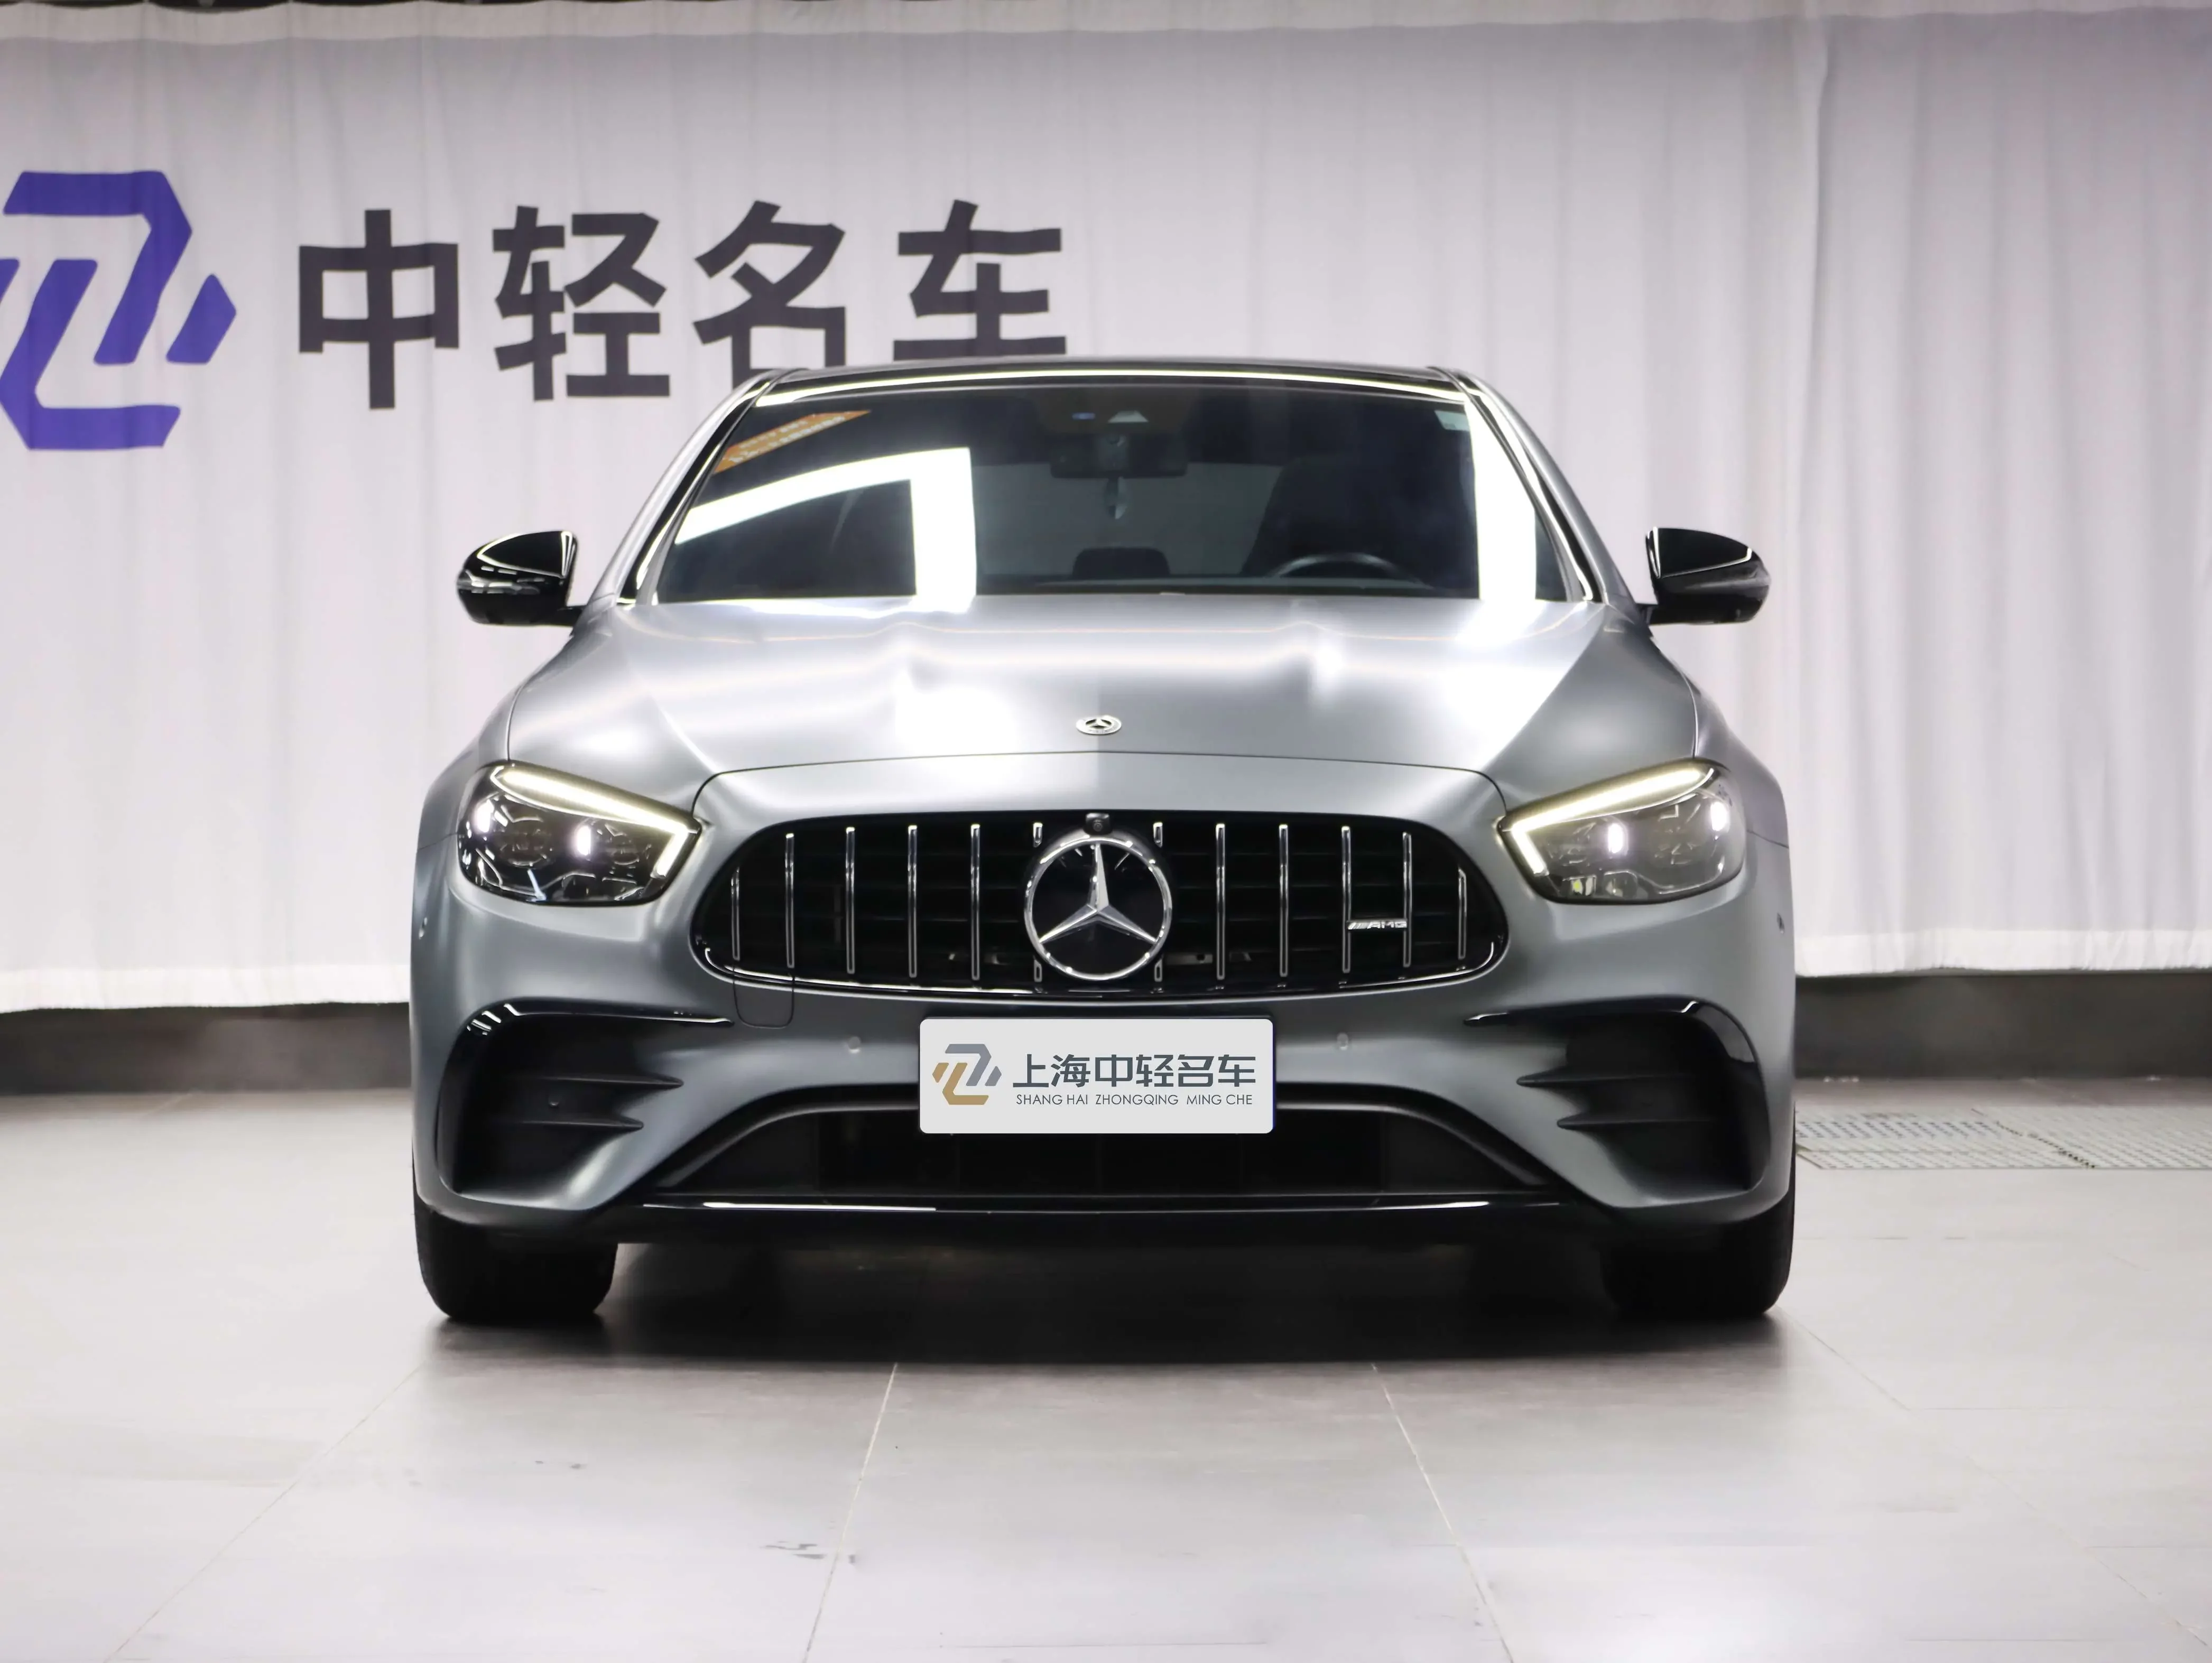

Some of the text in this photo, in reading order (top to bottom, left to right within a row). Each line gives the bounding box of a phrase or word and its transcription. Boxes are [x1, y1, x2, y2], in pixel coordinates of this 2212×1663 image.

[299, 200, 1066, 409] 中轻名车
[1366, 921, 1408, 929] AMG
